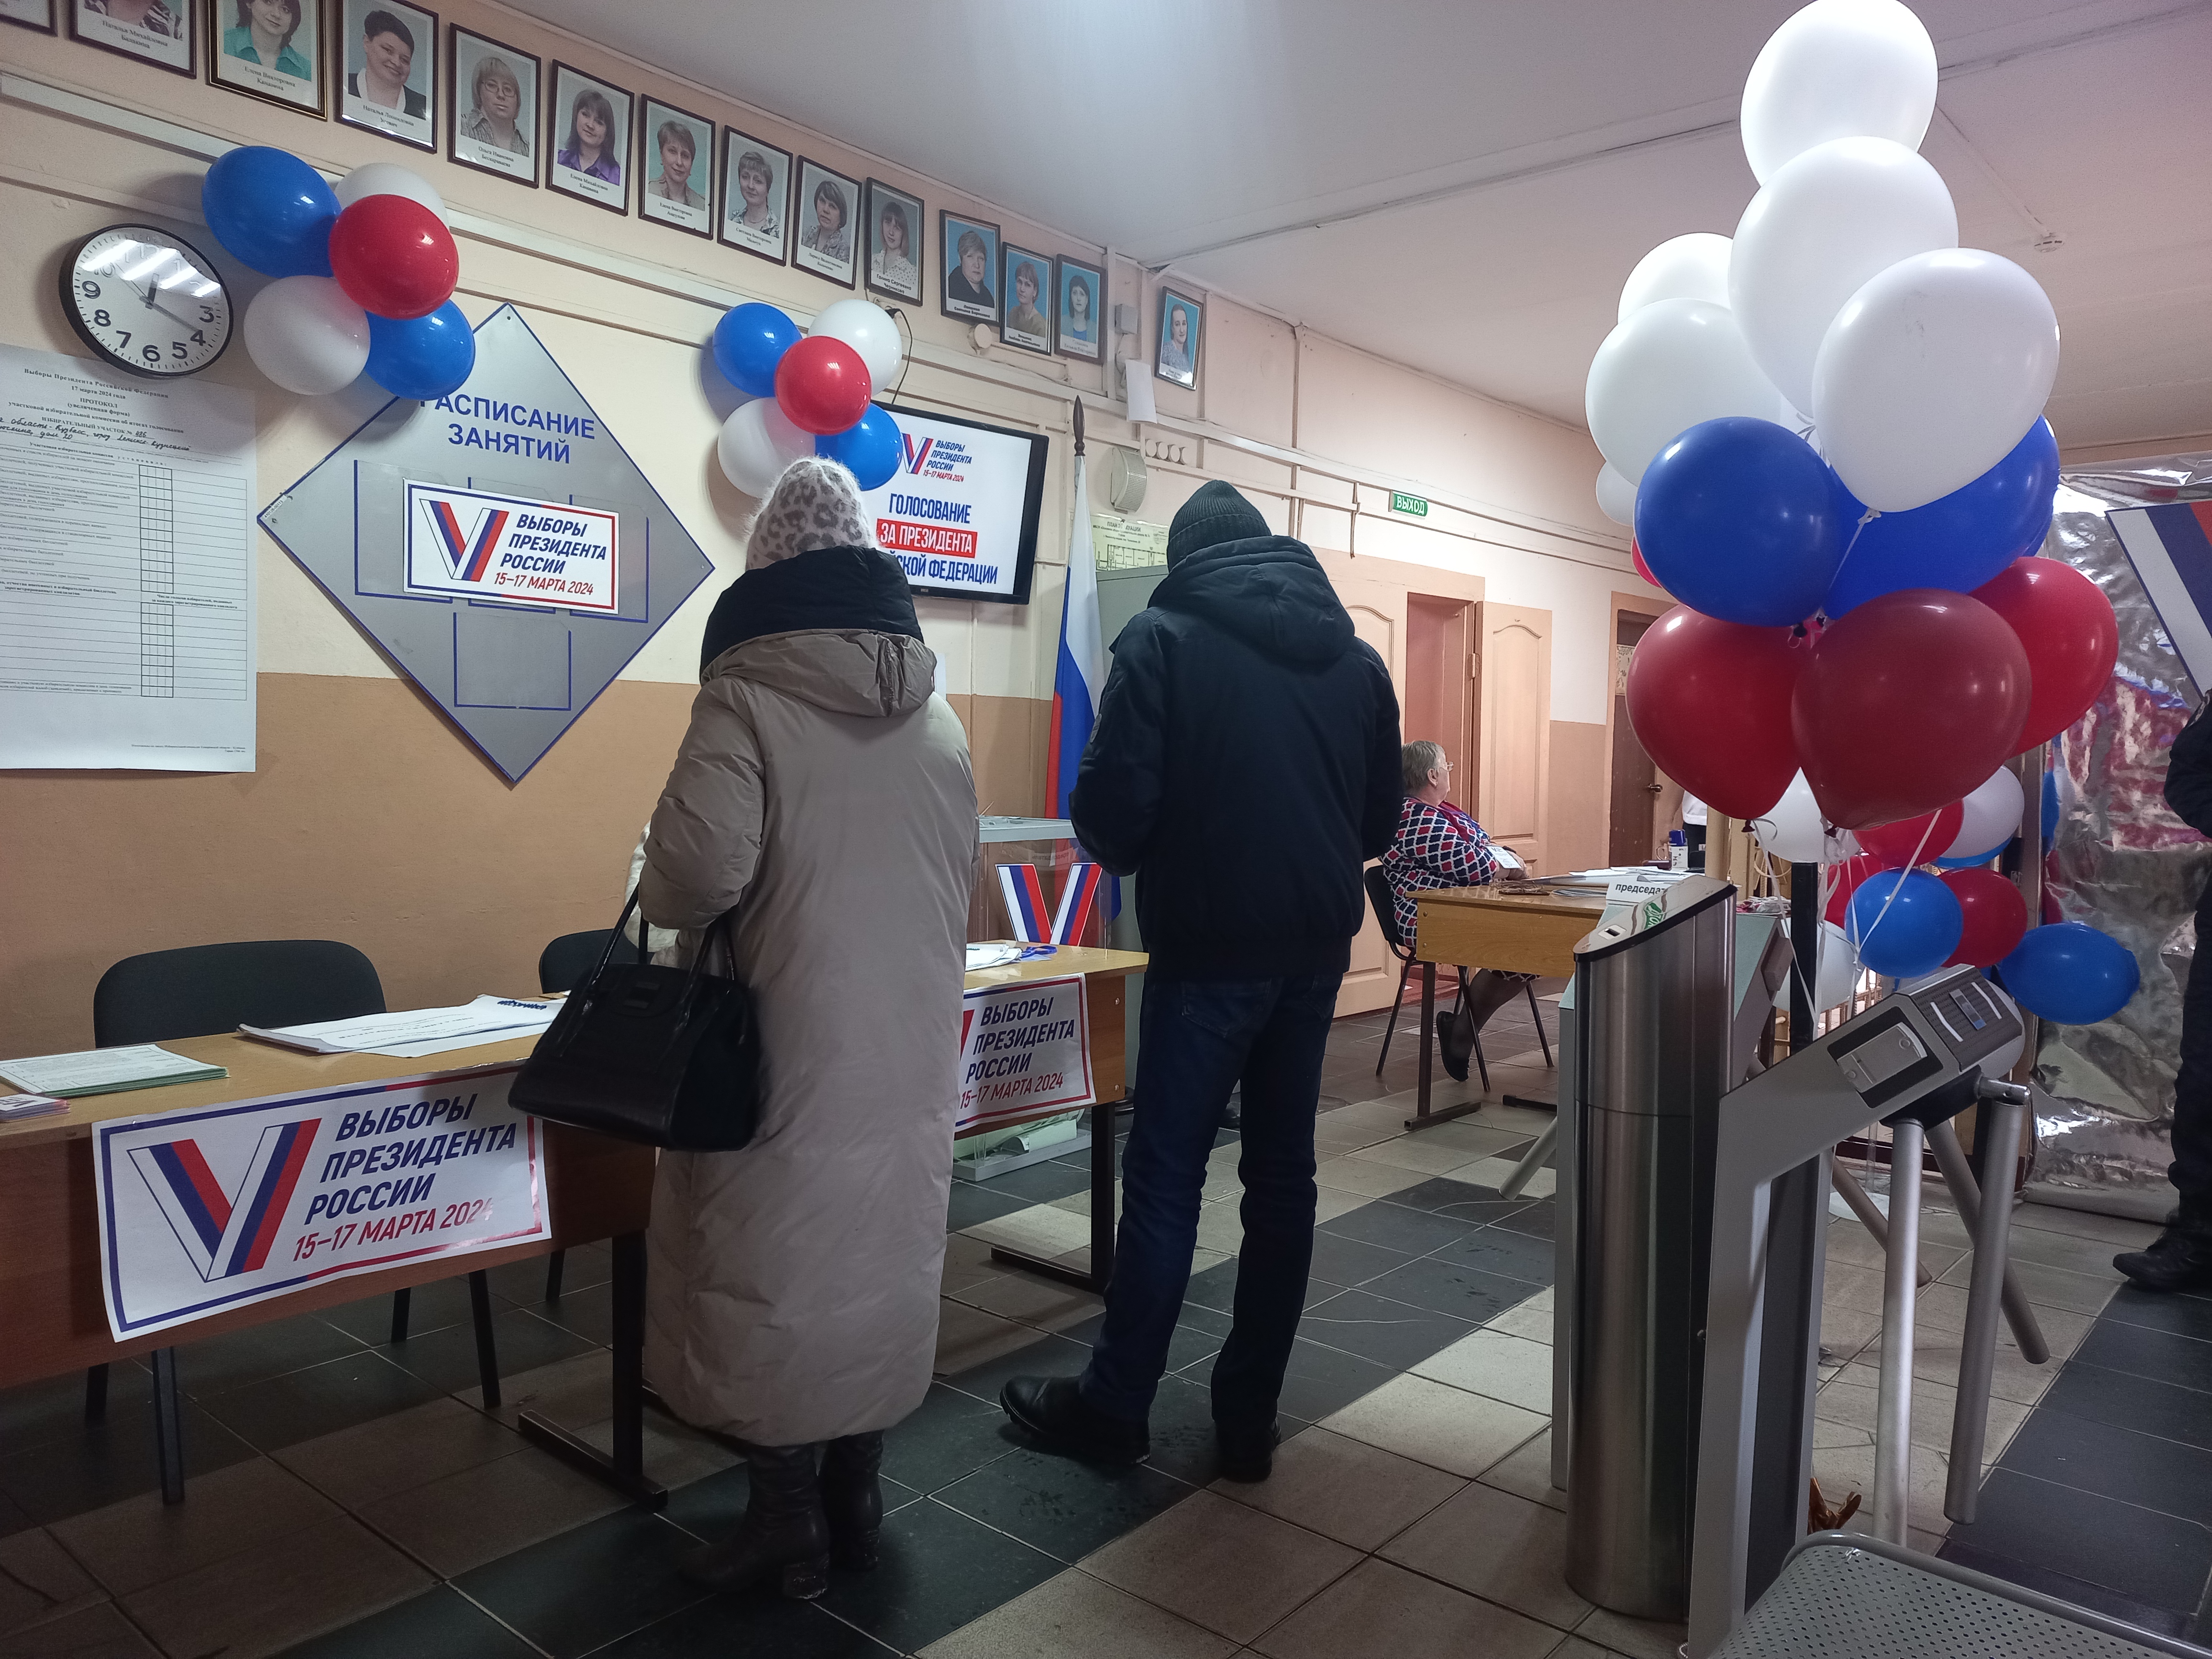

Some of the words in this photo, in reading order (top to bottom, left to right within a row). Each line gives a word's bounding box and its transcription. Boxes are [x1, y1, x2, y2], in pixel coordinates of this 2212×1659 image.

[245, 66, 261, 76] Елена
[82, 281, 101, 299] 9
[94, 310, 111, 327] 8
[199, 305, 214, 323] 3
[116, 330, 131, 348] 7
[190, 330, 206, 346] 4
[143, 345, 160, 362] 6
[171, 341, 188, 359] 5
[24, 369, 52, 377] Выборы
[55, 374, 92, 385] Президента
[95, 381, 132, 392] Российской
[8, 401, 44, 411] участковой
[45, 408, 90, 418] избирательной
[80, 398, 117, 408] ПРОТОКОЛ
[42, 417, 95, 429] ИЗБИРАТЕЛЬНЫЙ
[97, 425, 125, 433] УЧАСТОК
[420, 394, 595, 440] АСПИСАНИЕ
[448, 423, 570, 464] ЗАНЯТИЙ
[936, 440, 965, 453] ВЫБОРЫ
[927, 461, 954, 471] РОССИИ
[931, 451, 972, 465] ПРЕЗИДЕНТА
[937, 473, 952, 481] МАРТА
[889, 493, 971, 524] ГОЛОСОВАНИЕ
[1396, 496, 1424, 515] ВЫХОД
[517, 514, 587, 537] ВЫБОРЫ
[508, 533, 607, 560] ПРЕЗИДЕНТА
[880, 522, 896, 544] ЗА
[899, 525, 973, 553] ПРЕЗИДЕНТА
[500, 553, 566, 574] РОССИИ
[929, 559, 998, 585] ФЕДЕРАЦИИ
[527, 576, 565, 592] МАРТА
[567, 581, 594, 595] 2024
[980, 997, 1054, 1027] ВЫБОРЫ
[973, 1019, 1075, 1055] ПРЕЗИДЕНТА
[966, 1052, 1032, 1084] РОССИИ
[991, 1077, 1032, 1102] МАРТА
[1034, 1072, 1063, 1092] 2024
[335, 1093, 478, 1142] ВЫБОРЫ
[320, 1124, 517, 1183] ПРЕЗИДЕНТА
[305, 1173, 436, 1225] РОССИИ
[357, 1209, 437, 1246] МАРТА
